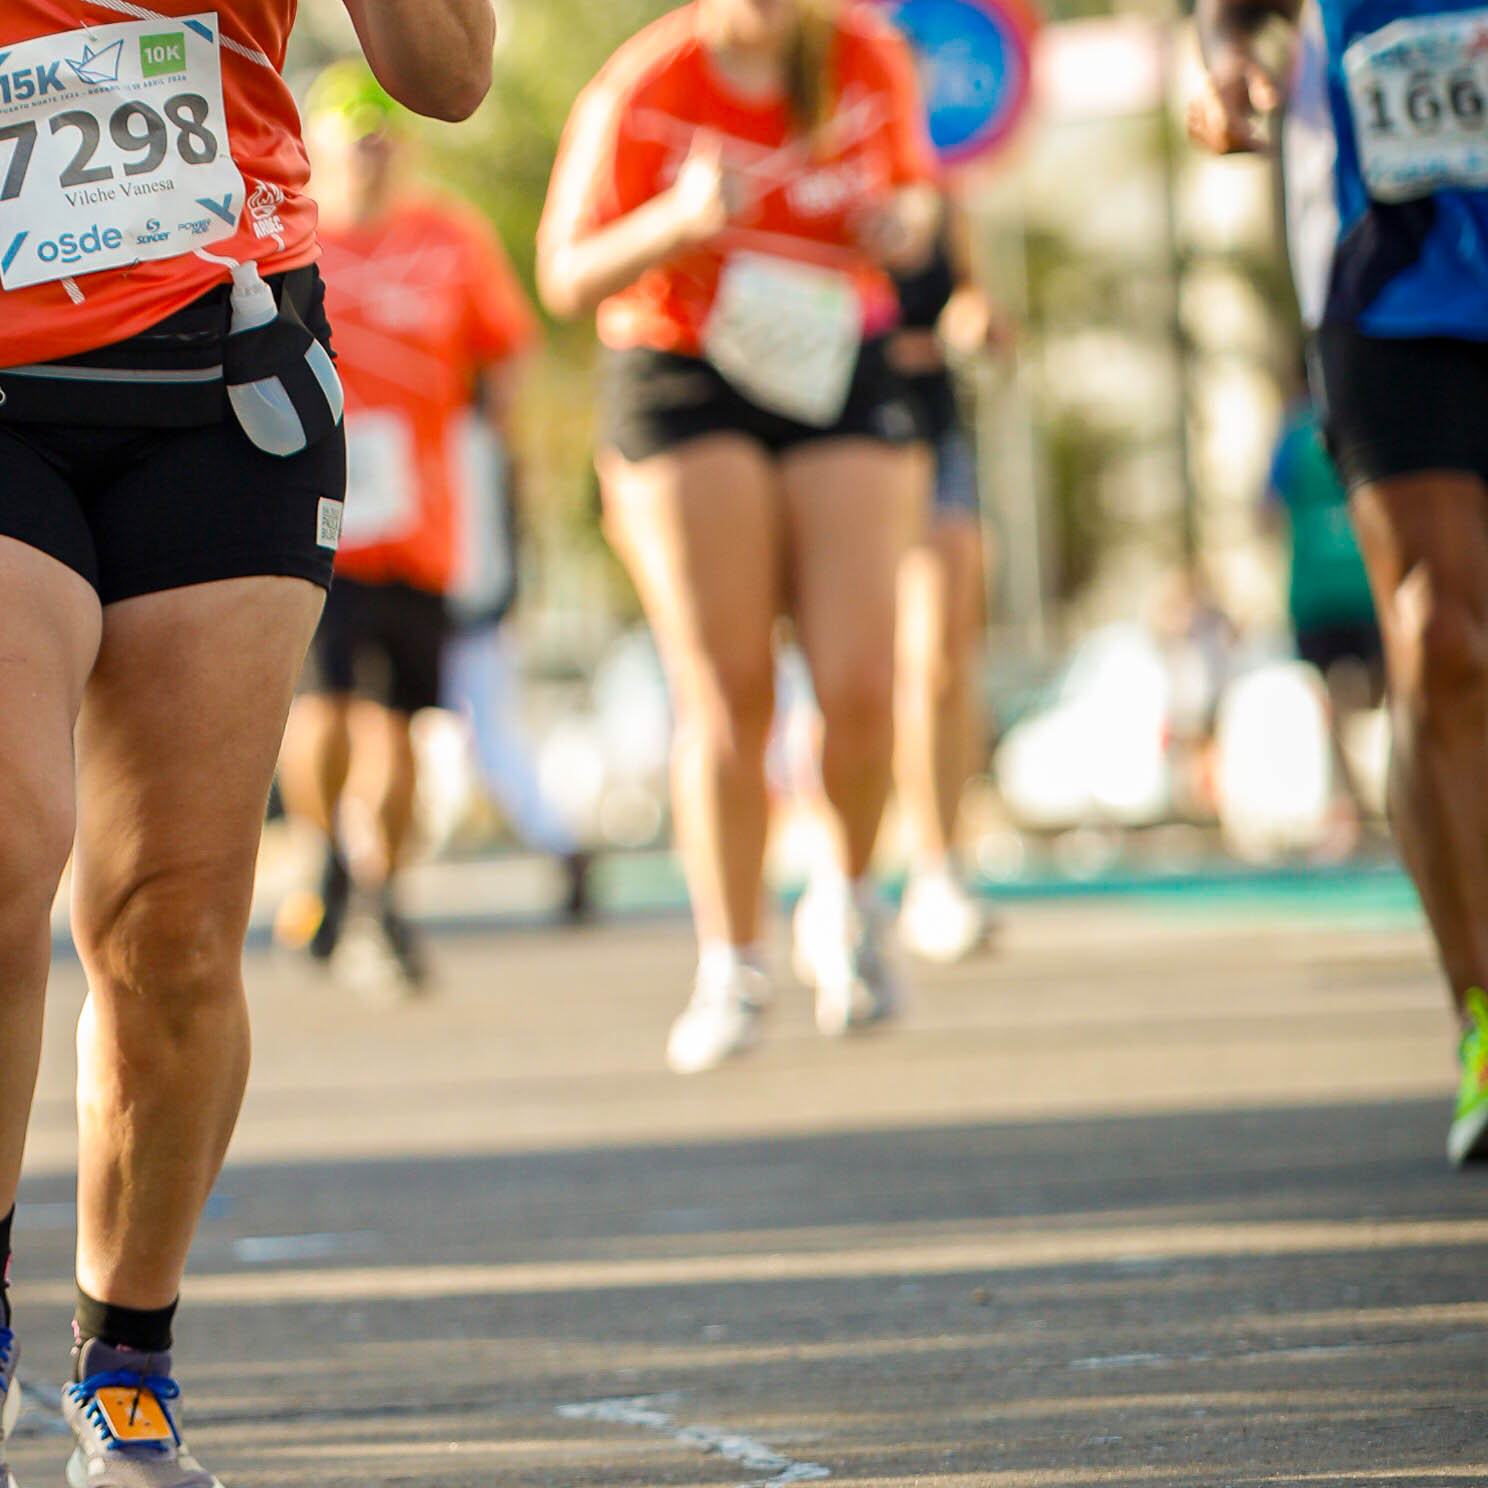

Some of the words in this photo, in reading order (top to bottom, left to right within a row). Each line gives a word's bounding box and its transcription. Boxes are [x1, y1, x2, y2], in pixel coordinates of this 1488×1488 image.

[144, 45, 181, 64] 10K
[64, 187, 117, 208] Vilche
[119, 178, 176, 198] Vanesa
[37, 223, 122, 262] osde
